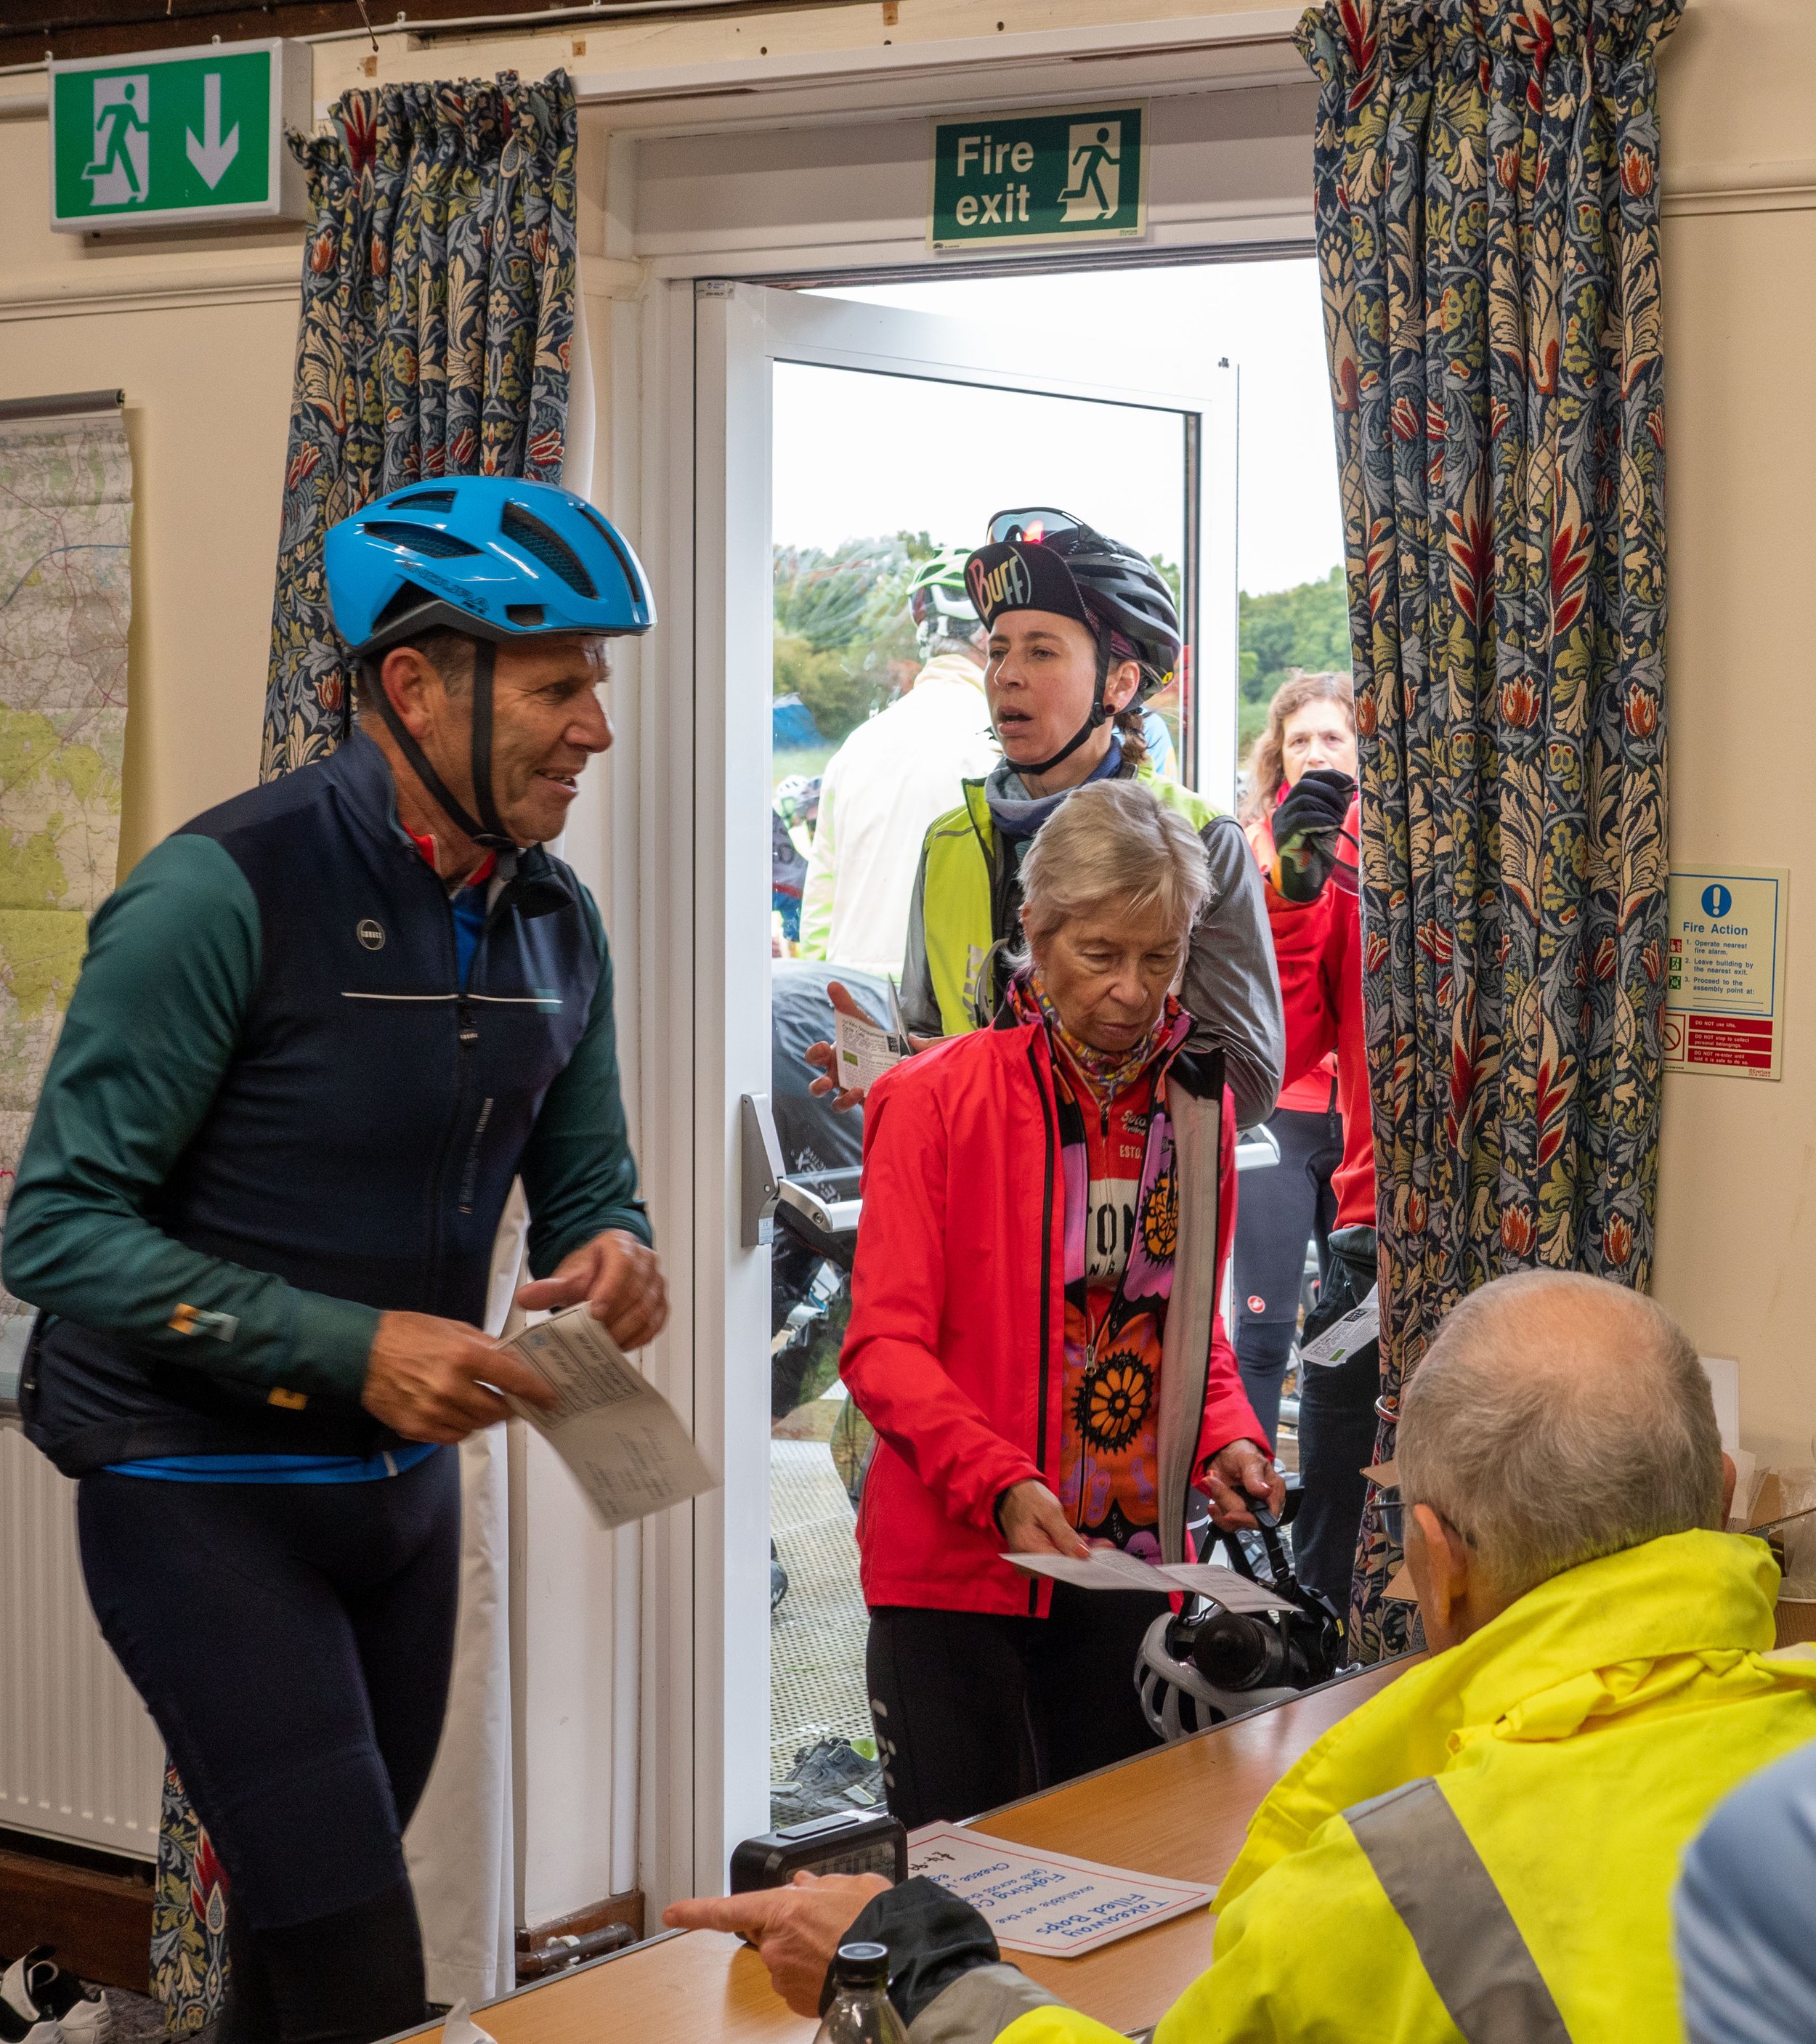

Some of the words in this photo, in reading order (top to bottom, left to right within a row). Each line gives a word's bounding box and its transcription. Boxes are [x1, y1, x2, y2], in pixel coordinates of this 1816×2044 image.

[957, 135, 1034, 177] Fire
[956, 182, 1030, 226] exit
[1683, 922, 1704, 933] Fire
[1711, 924, 1748, 936] Action
[1693, 985, 1723, 994] assembly
[983, 1879, 1017, 1893] across
[992, 1873, 1066, 1899] Fighting
[1039, 1886, 1095, 1907] available
[1087, 1893, 1146, 1915] Filled
[996, 1914, 1021, 1924] the
[1036, 1914, 1091, 1935] Baps
[1061, 1900, 1170, 1937] Takeaway
